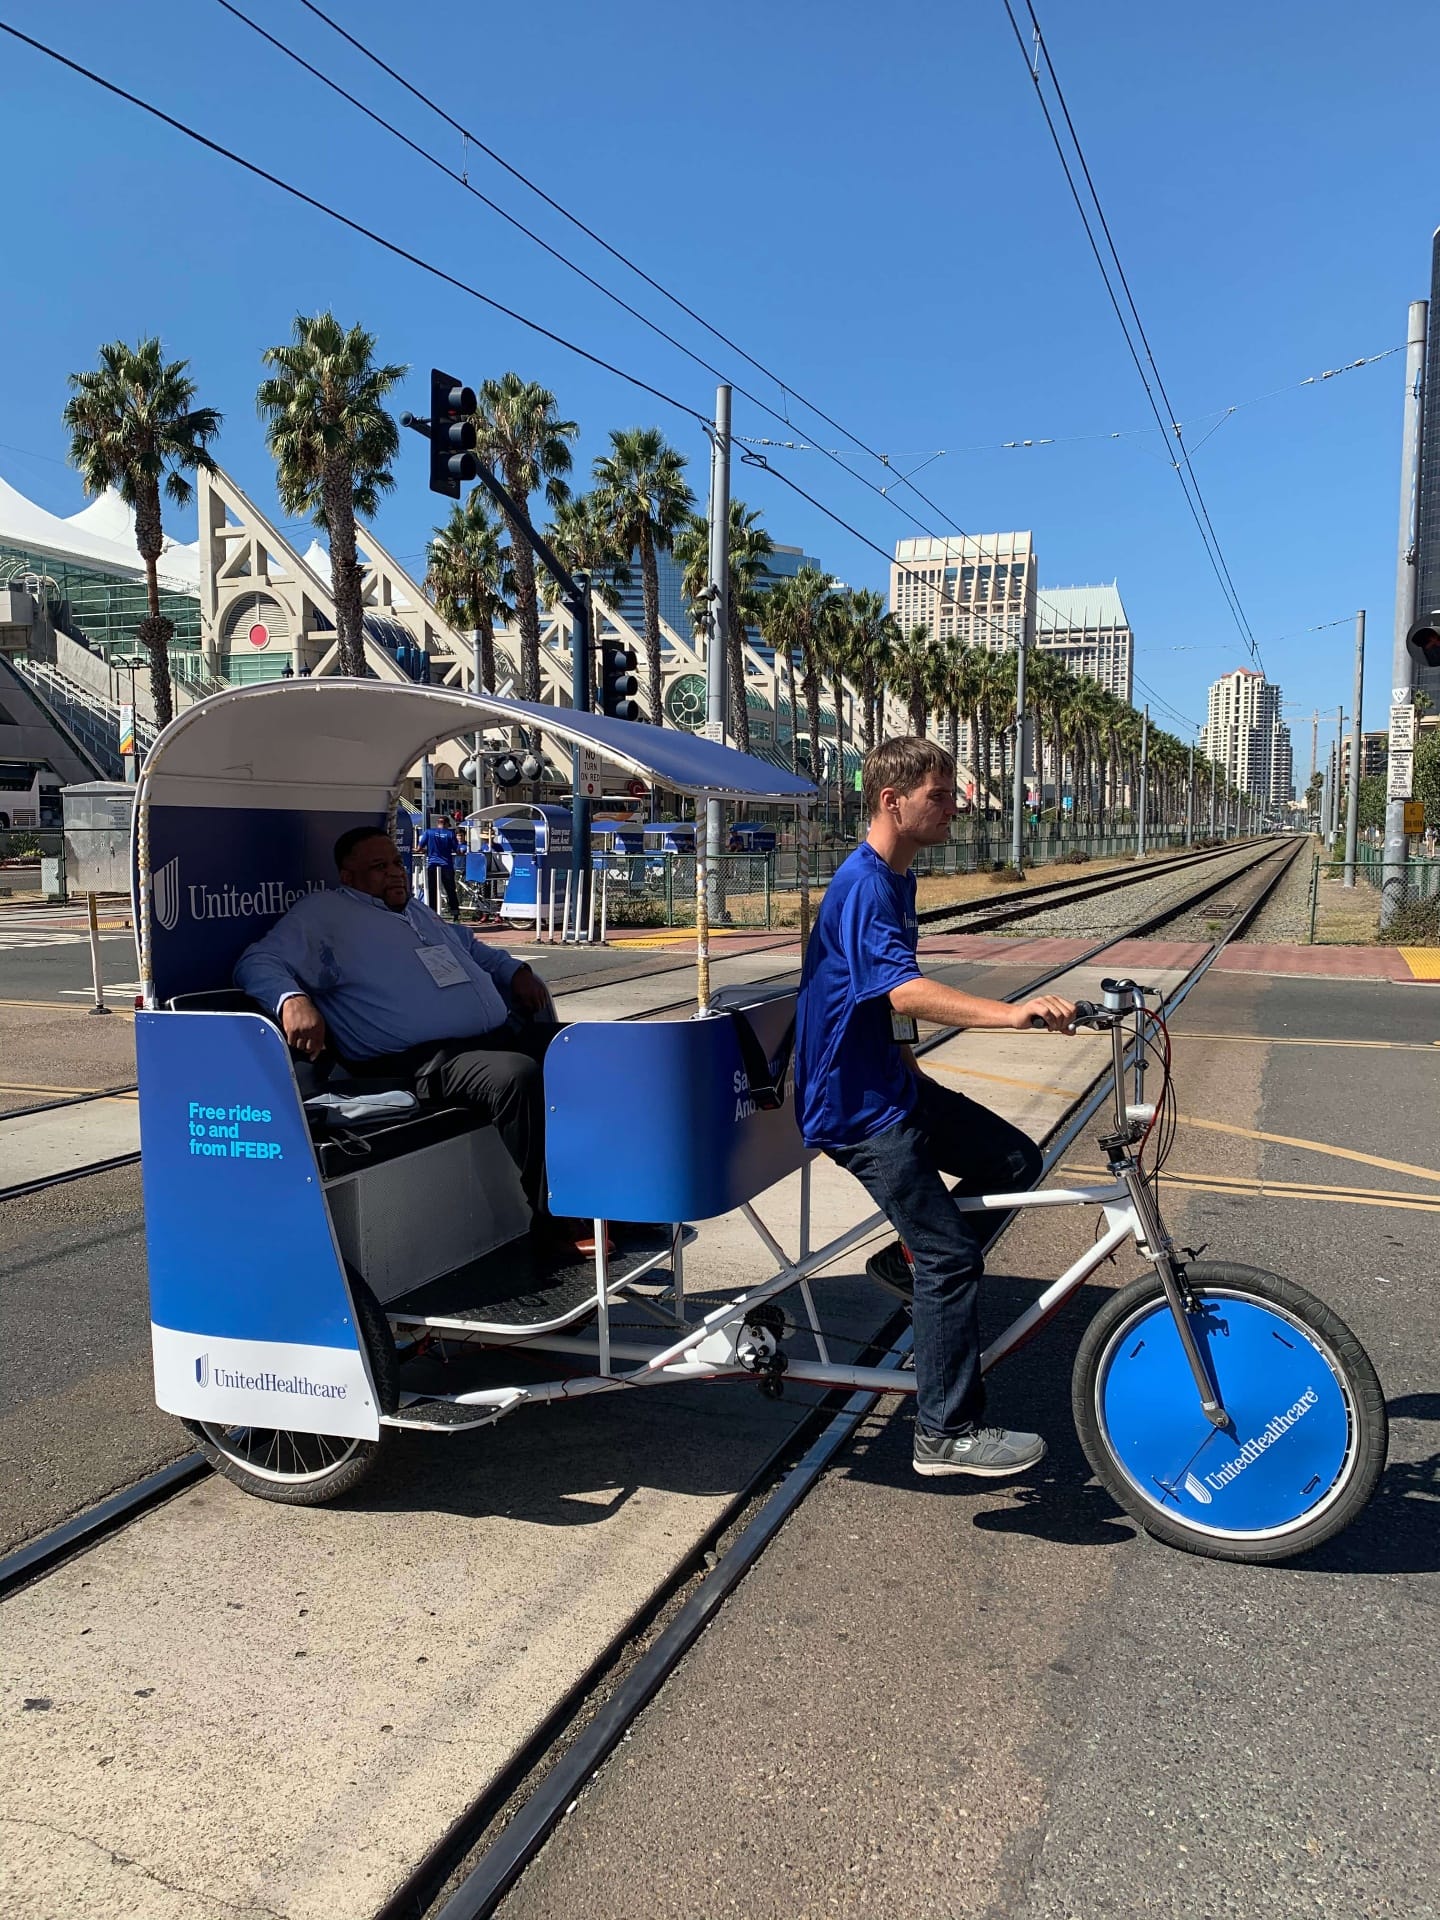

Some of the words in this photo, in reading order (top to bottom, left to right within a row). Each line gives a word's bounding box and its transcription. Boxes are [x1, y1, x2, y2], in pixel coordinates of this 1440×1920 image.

[584, 762, 598, 770] TURN
[585, 750, 596, 761] NO
[581, 773, 588, 781] ON
[734, 1070, 750, 1094] Sa
[188, 1101, 226, 1121] Free
[228, 1104, 272, 1123] rides
[188, 1120, 206, 1137] to
[208, 1122, 239, 1139] and
[189, 1138, 228, 1157] from
[230, 1141, 284, 1160] IFEBP.
[213, 1368, 348, 1400] UnitedHealthcare
[1204, 1389, 1320, 1491] UnitedHealthcare
